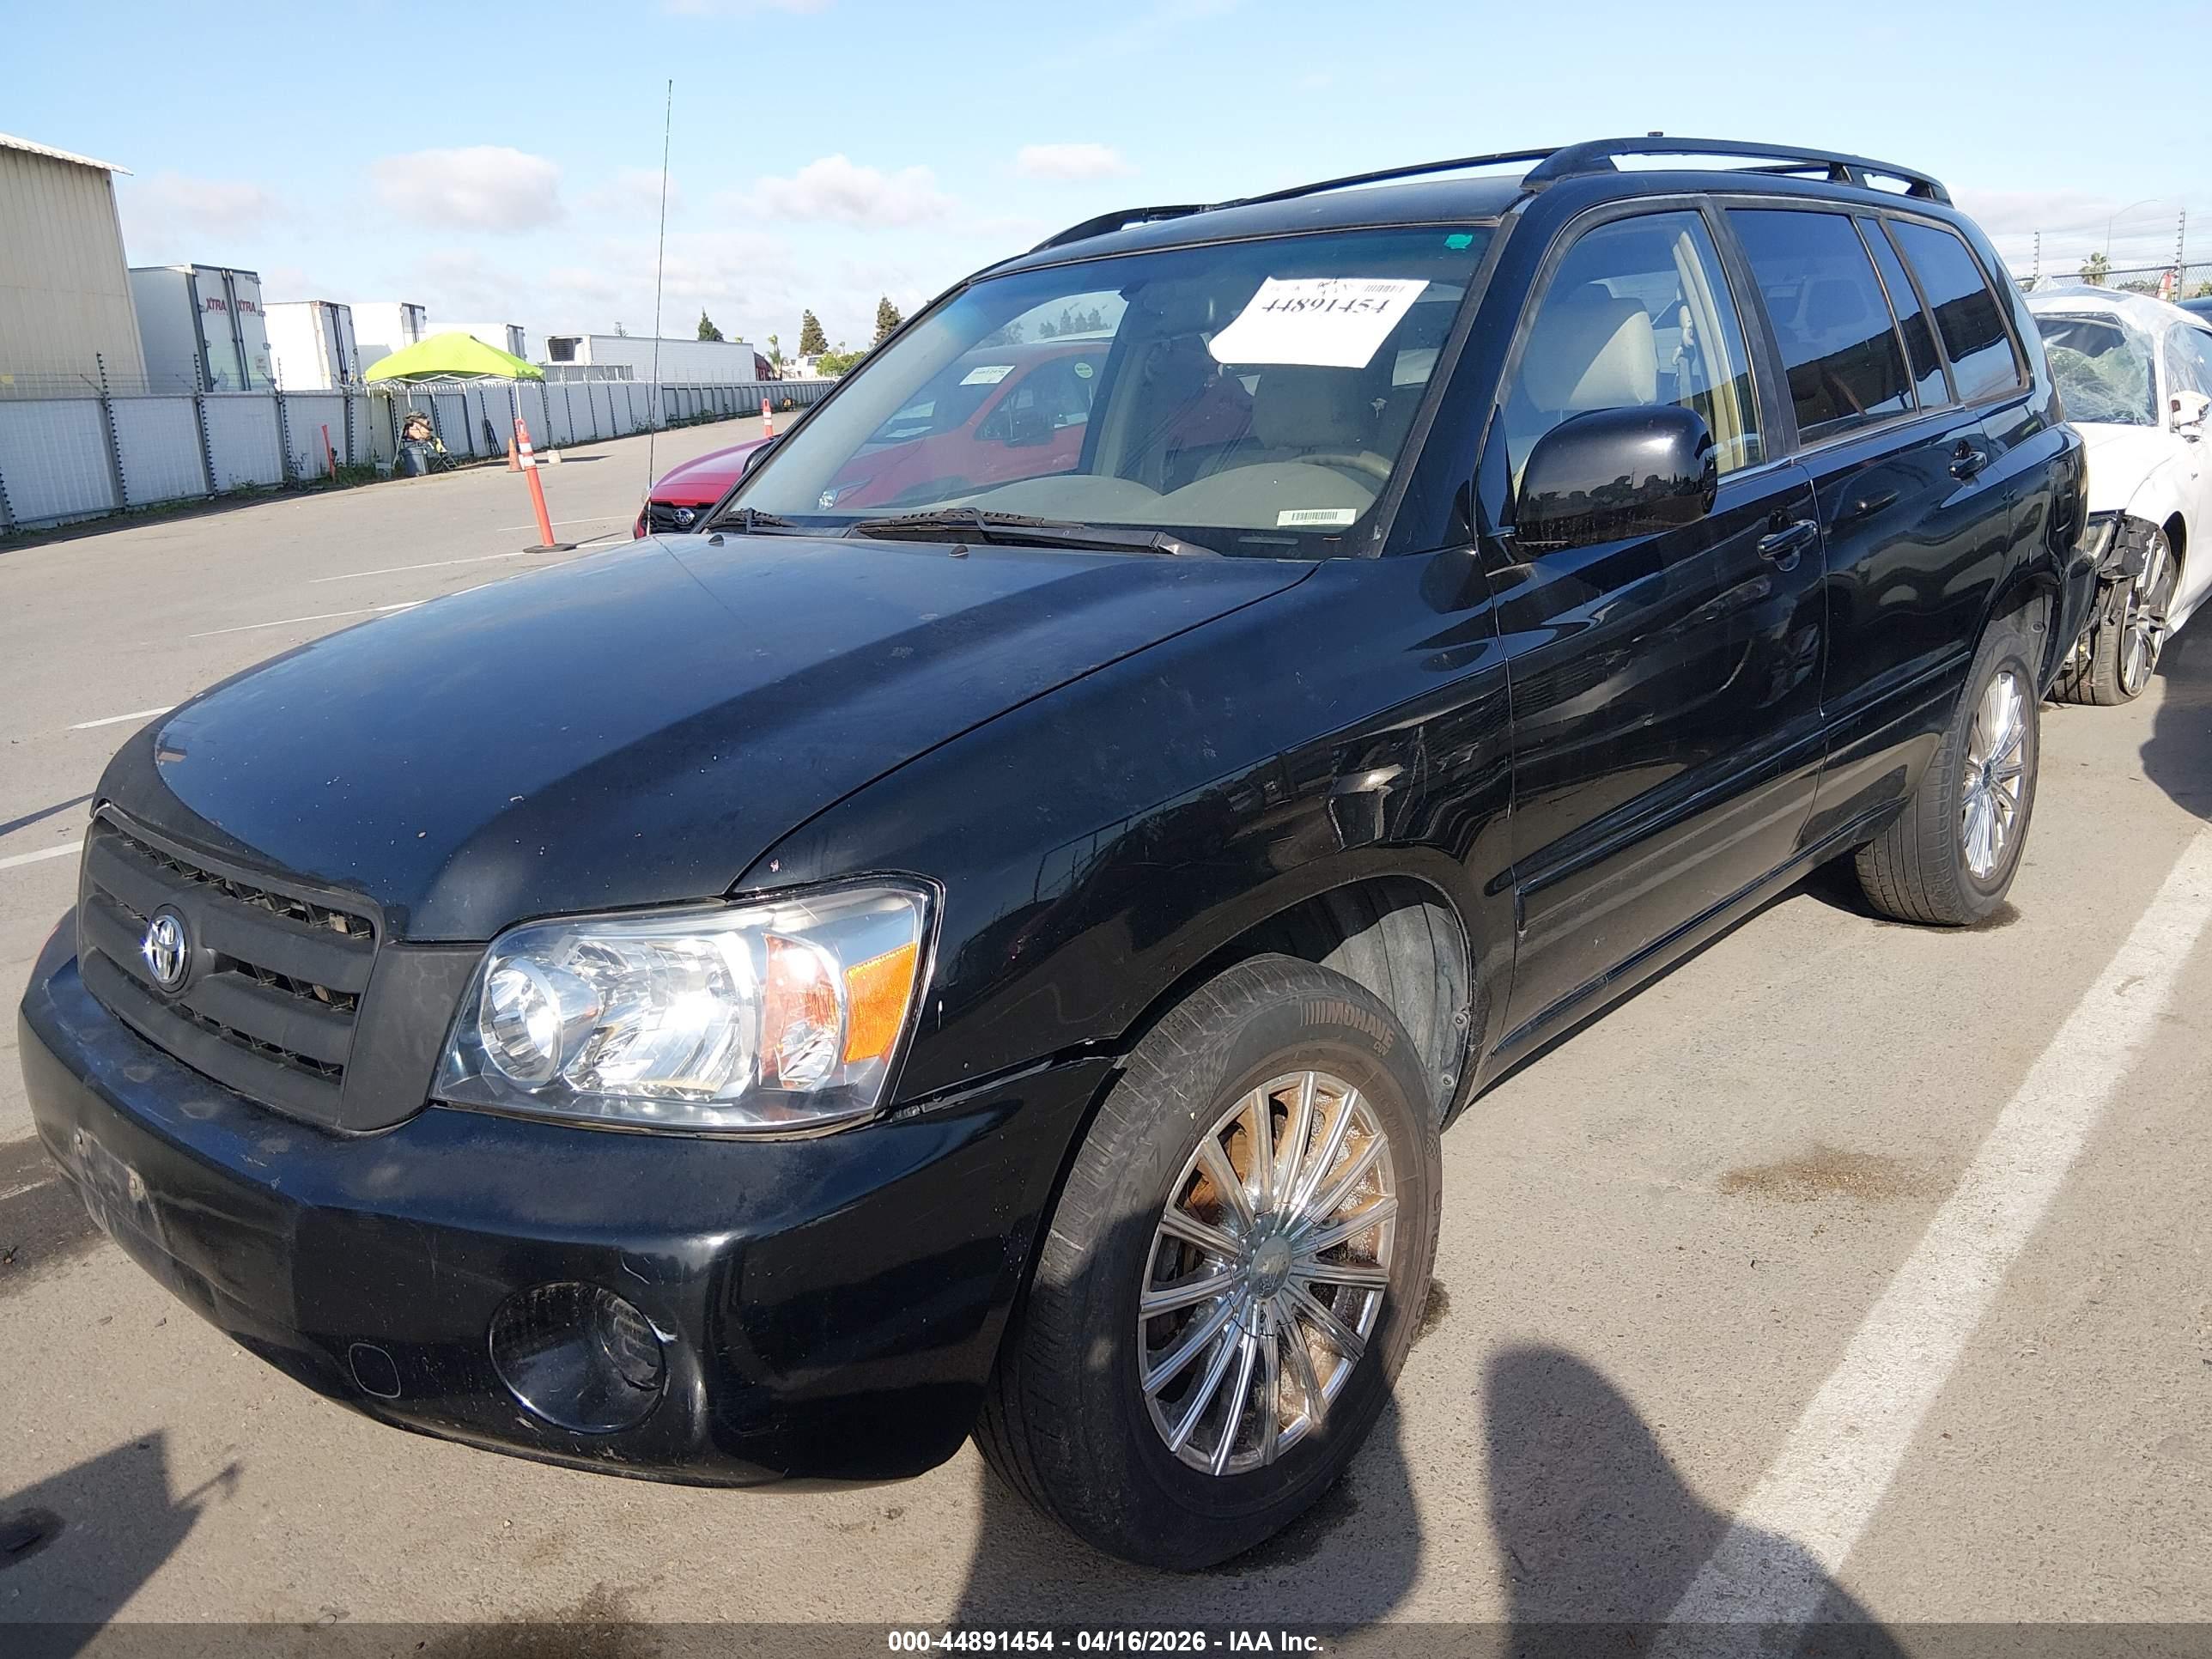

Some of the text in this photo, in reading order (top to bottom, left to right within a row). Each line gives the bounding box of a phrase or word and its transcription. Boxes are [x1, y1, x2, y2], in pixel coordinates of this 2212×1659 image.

[206, 297, 228, 312] XTRA
[238, 299, 257, 313] XTRA
[1261, 298, 1390, 313] 44891454
[1326, 1001, 1395, 1047] MOHAVE
